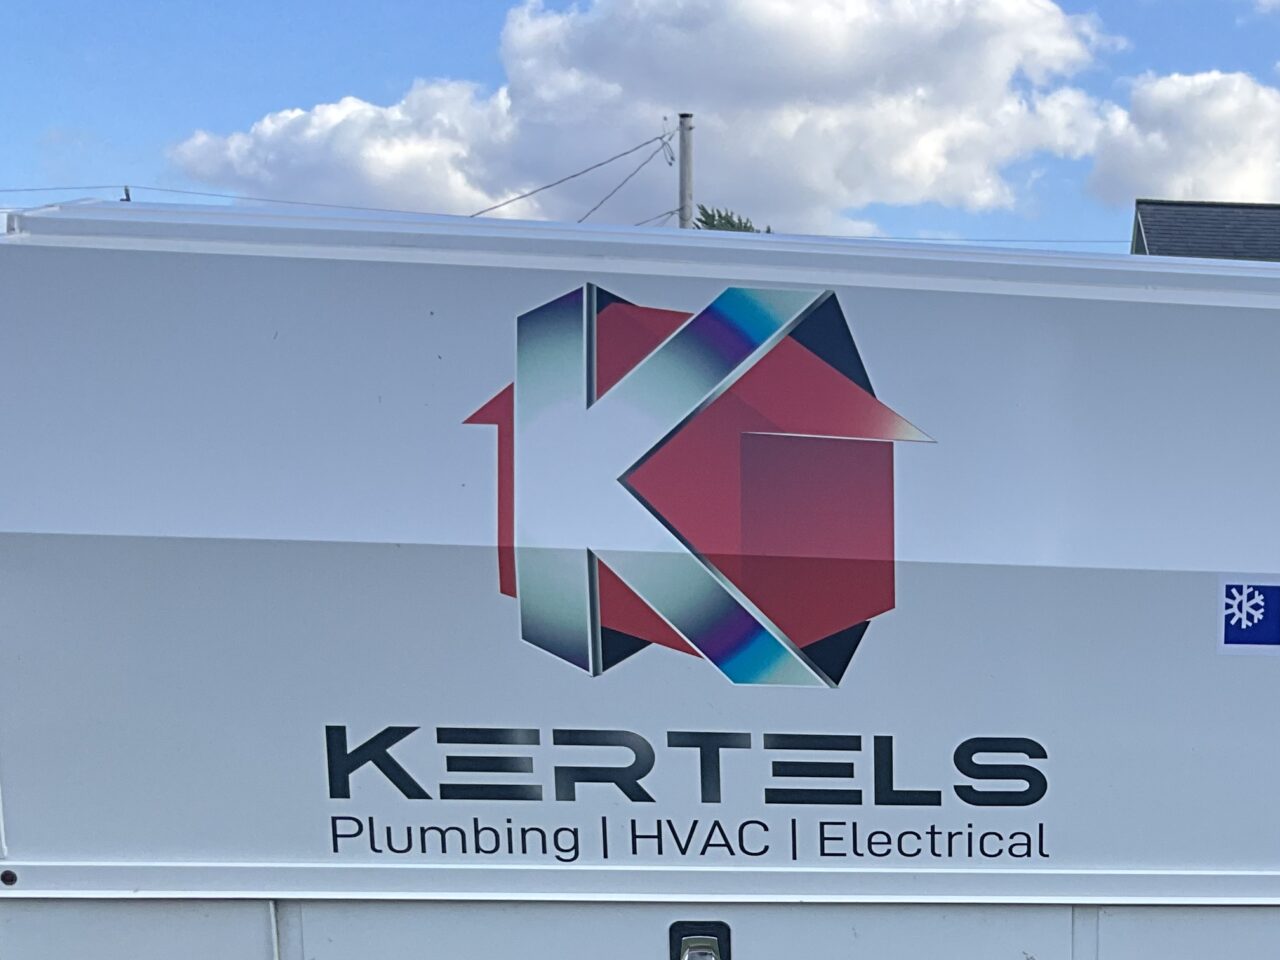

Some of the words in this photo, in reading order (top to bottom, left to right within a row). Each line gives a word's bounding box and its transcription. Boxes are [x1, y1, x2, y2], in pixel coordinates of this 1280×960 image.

[324, 724, 1049, 807] KERTELS
[330, 815, 581, 863] Plumbing
[630, 819, 770, 858] HVAC
[819, 820, 1050, 860] Electrical
